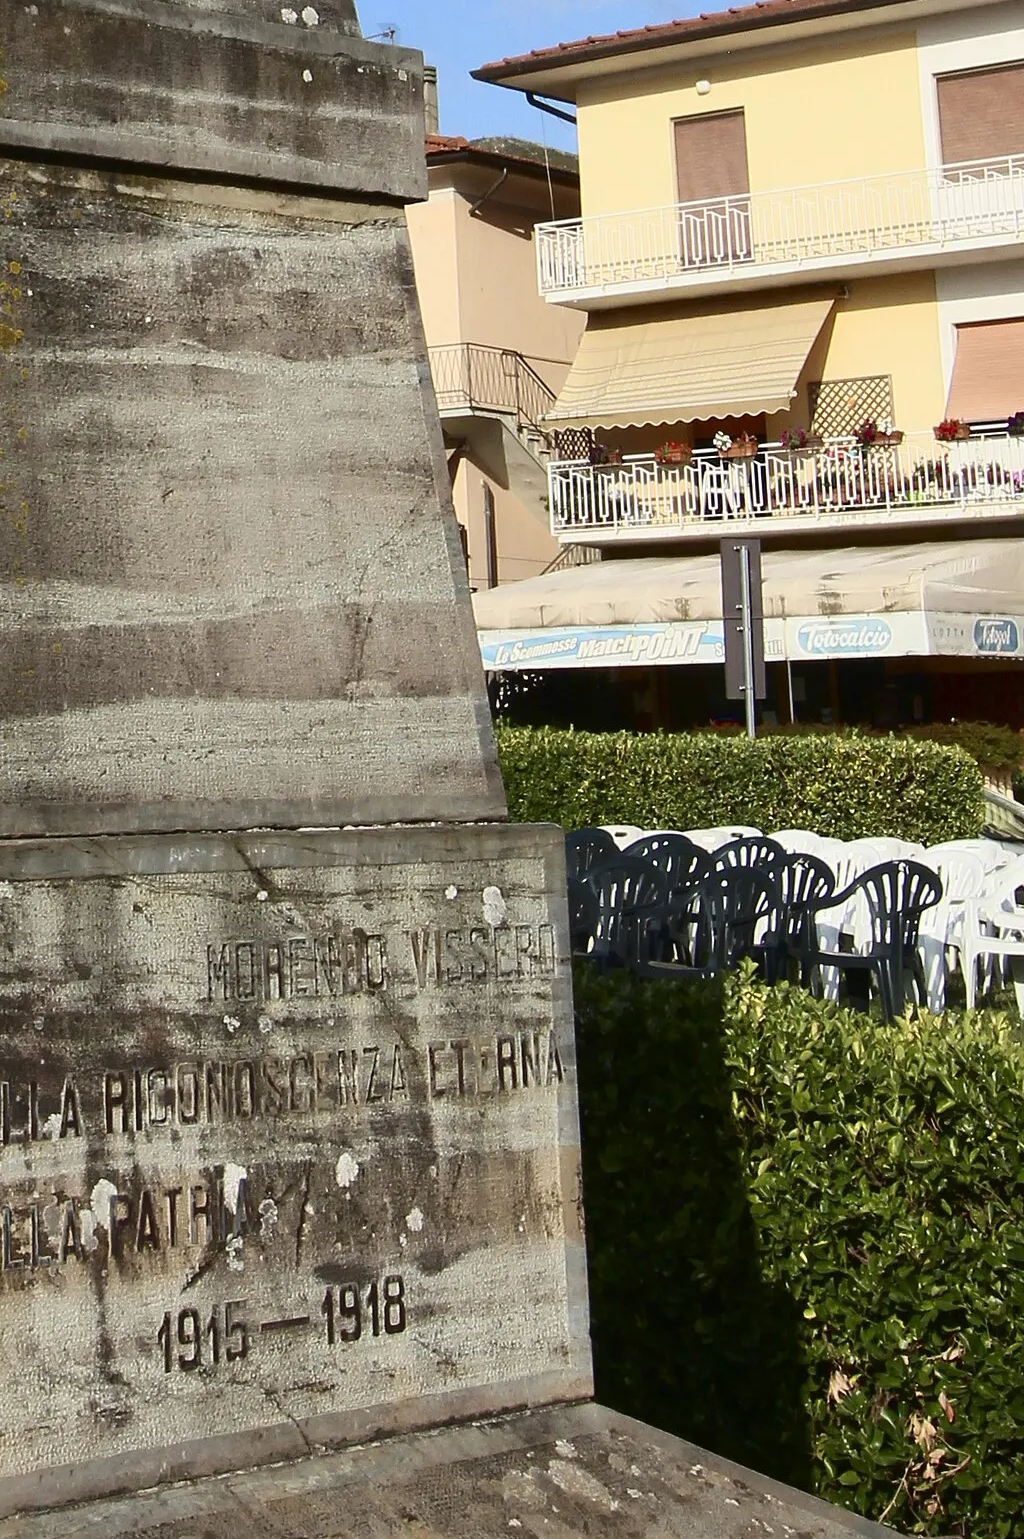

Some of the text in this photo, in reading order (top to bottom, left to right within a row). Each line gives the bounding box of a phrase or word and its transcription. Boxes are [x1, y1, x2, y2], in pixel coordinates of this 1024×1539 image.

[510, 637, 578, 663] Scommesse
[800, 624, 891, 649] Totocalcio
[408, 924, 556, 989] VISSERO
[103, 1045, 407, 1136] RICONOSCENZA
[428, 1029, 564, 1099] ETERNA
[109, 1177, 254, 1259] PATRIA
